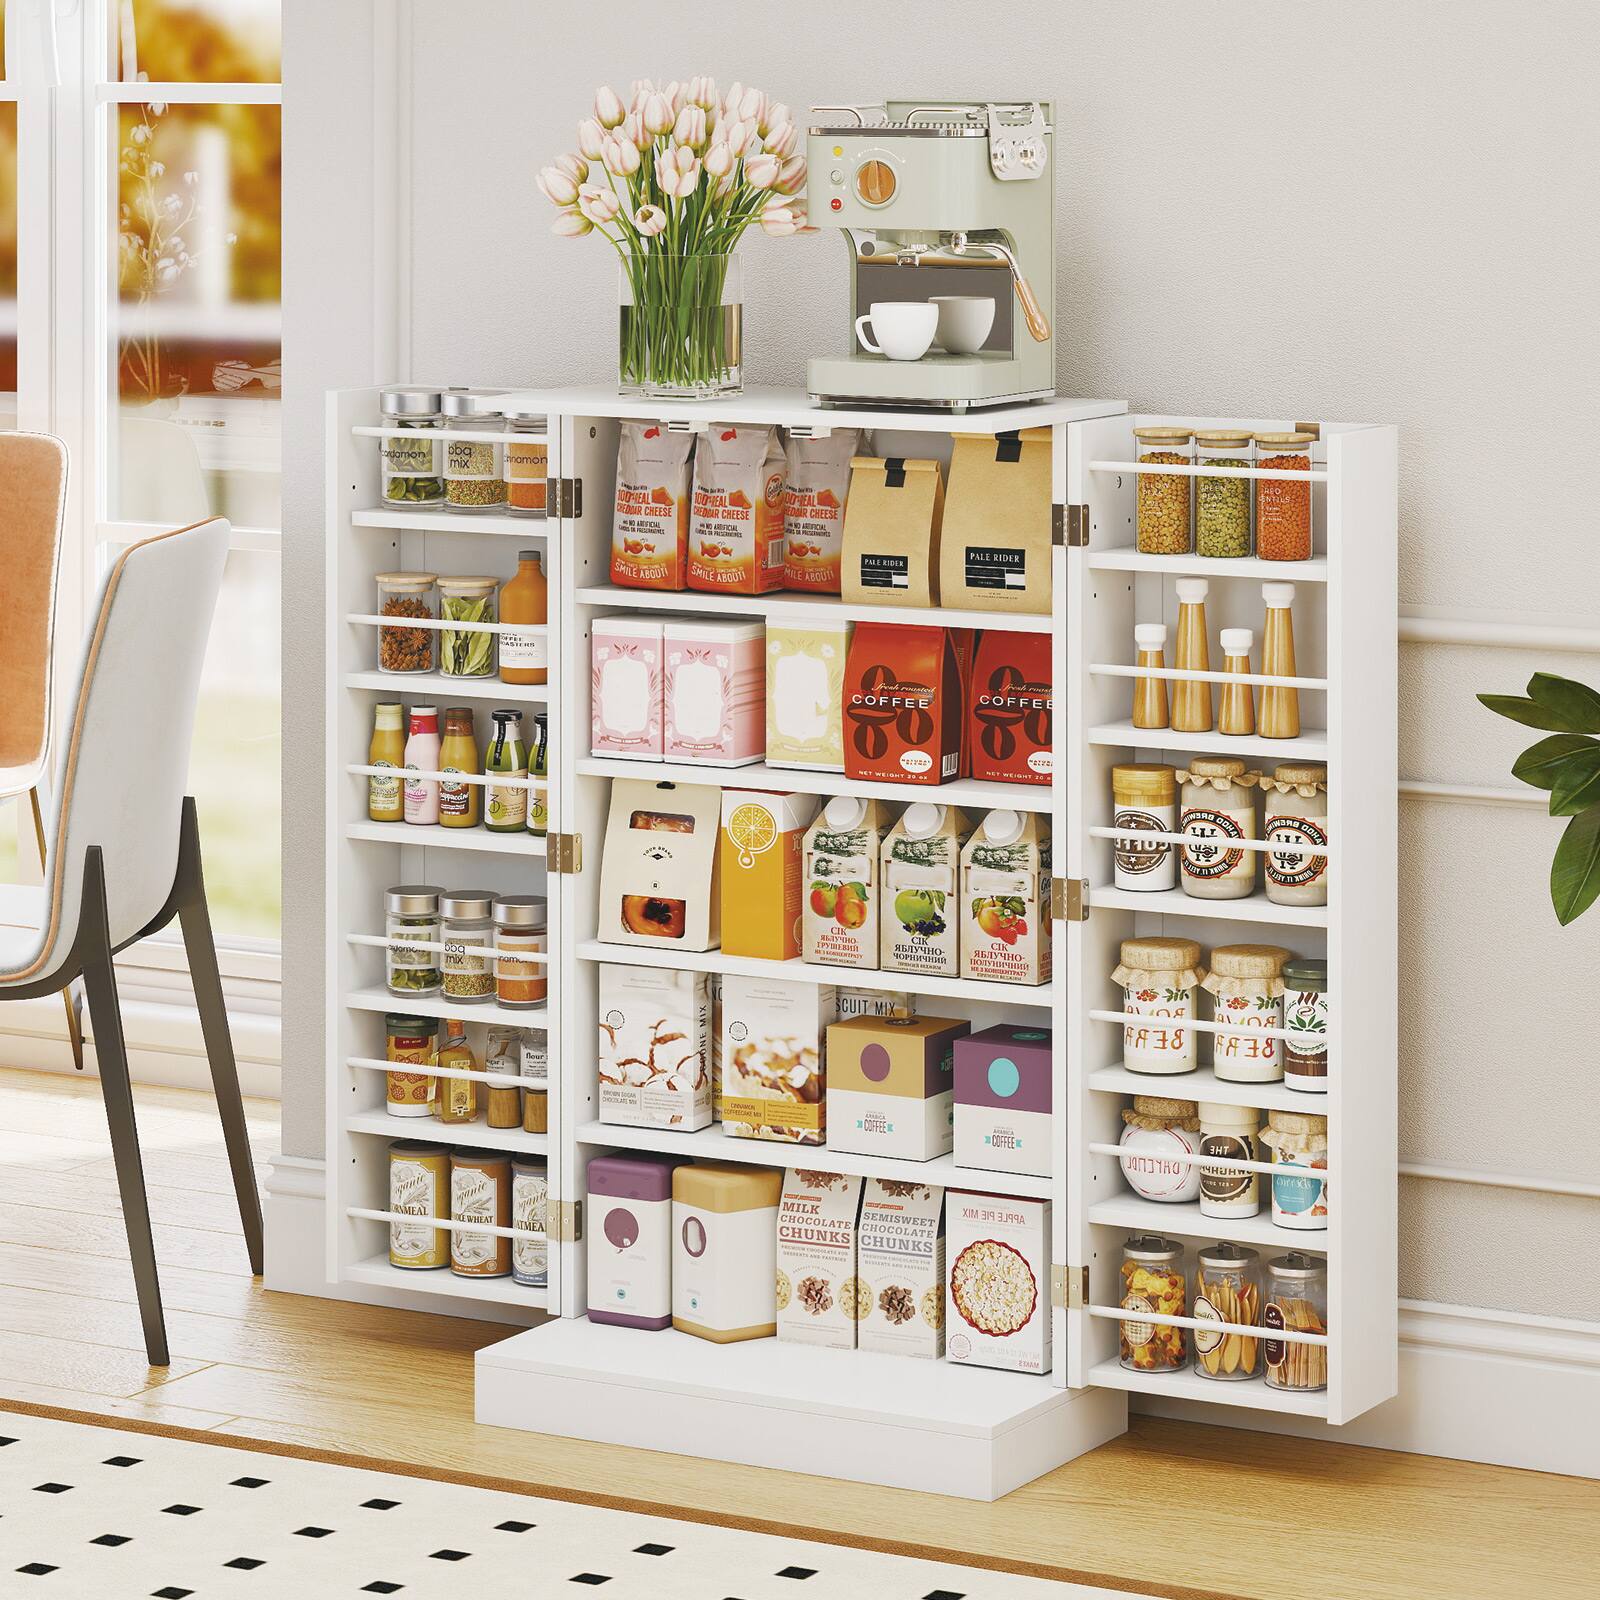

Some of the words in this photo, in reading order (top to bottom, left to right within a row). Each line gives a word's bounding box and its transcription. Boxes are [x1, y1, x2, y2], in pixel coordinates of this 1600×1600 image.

[448, 444, 472, 458] bbq
[450, 457, 470, 469] mix
[644, 506, 673, 518] CHEESE
[722, 510, 750, 520] CHEESE
[810, 508, 838, 520] CHEESE
[970, 552, 991, 562] PALE
[993, 554, 1020, 563] RIDER
[614, 562, 638, 578] SMILE
[692, 566, 714, 582] SMILE
[784, 567, 802, 580] MILE
[872, 682, 898, 692] fresh
[900, 684, 936, 694] roasted
[998, 684, 1026, 692] fresh
[852, 694, 930, 709] COFFEE
[894, 944, 945, 956] ЯБЛУЧНО-
[974, 950, 1025, 962] ЯБЛУЧНО-
[446, 954, 464, 965] mix
[893, 952, 947, 964] ЧОРНИЧНИЙ
[874, 1001, 896, 1016] MIX
[526, 1052, 544, 1060] flour
[864, 1119, 886, 1134] COFFEE
[992, 1134, 1015, 1149] COFFEE
[783, 1202, 820, 1214] MILK
[467, 1216, 494, 1224] WHEAT
[780, 1215, 852, 1230] CHOCOLATE
[863, 1212, 935, 1227] SEMISWEET
[779, 1226, 850, 1244] CHUNKS
[862, 1223, 934, 1239] CHOCOLATE
[861, 1235, 932, 1253] CHUNKS
